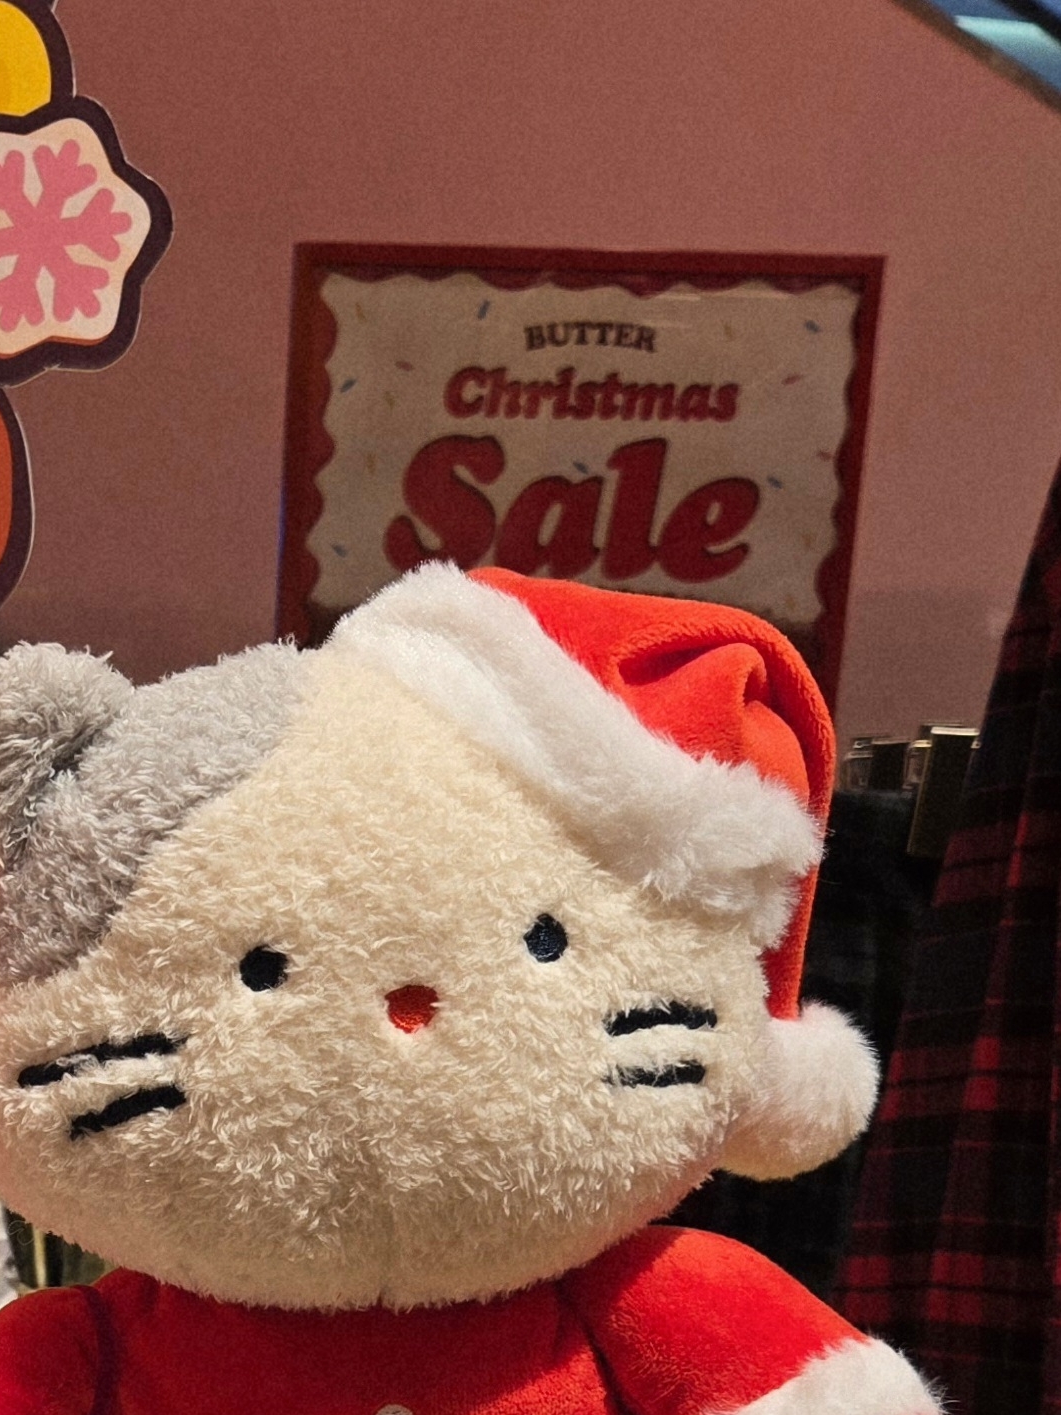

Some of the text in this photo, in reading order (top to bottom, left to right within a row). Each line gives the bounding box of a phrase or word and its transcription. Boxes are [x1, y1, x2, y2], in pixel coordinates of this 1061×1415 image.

[524, 320, 657, 354] BUTTER
[443, 364, 741, 424] Christmas
[383, 433, 762, 585] Sale
